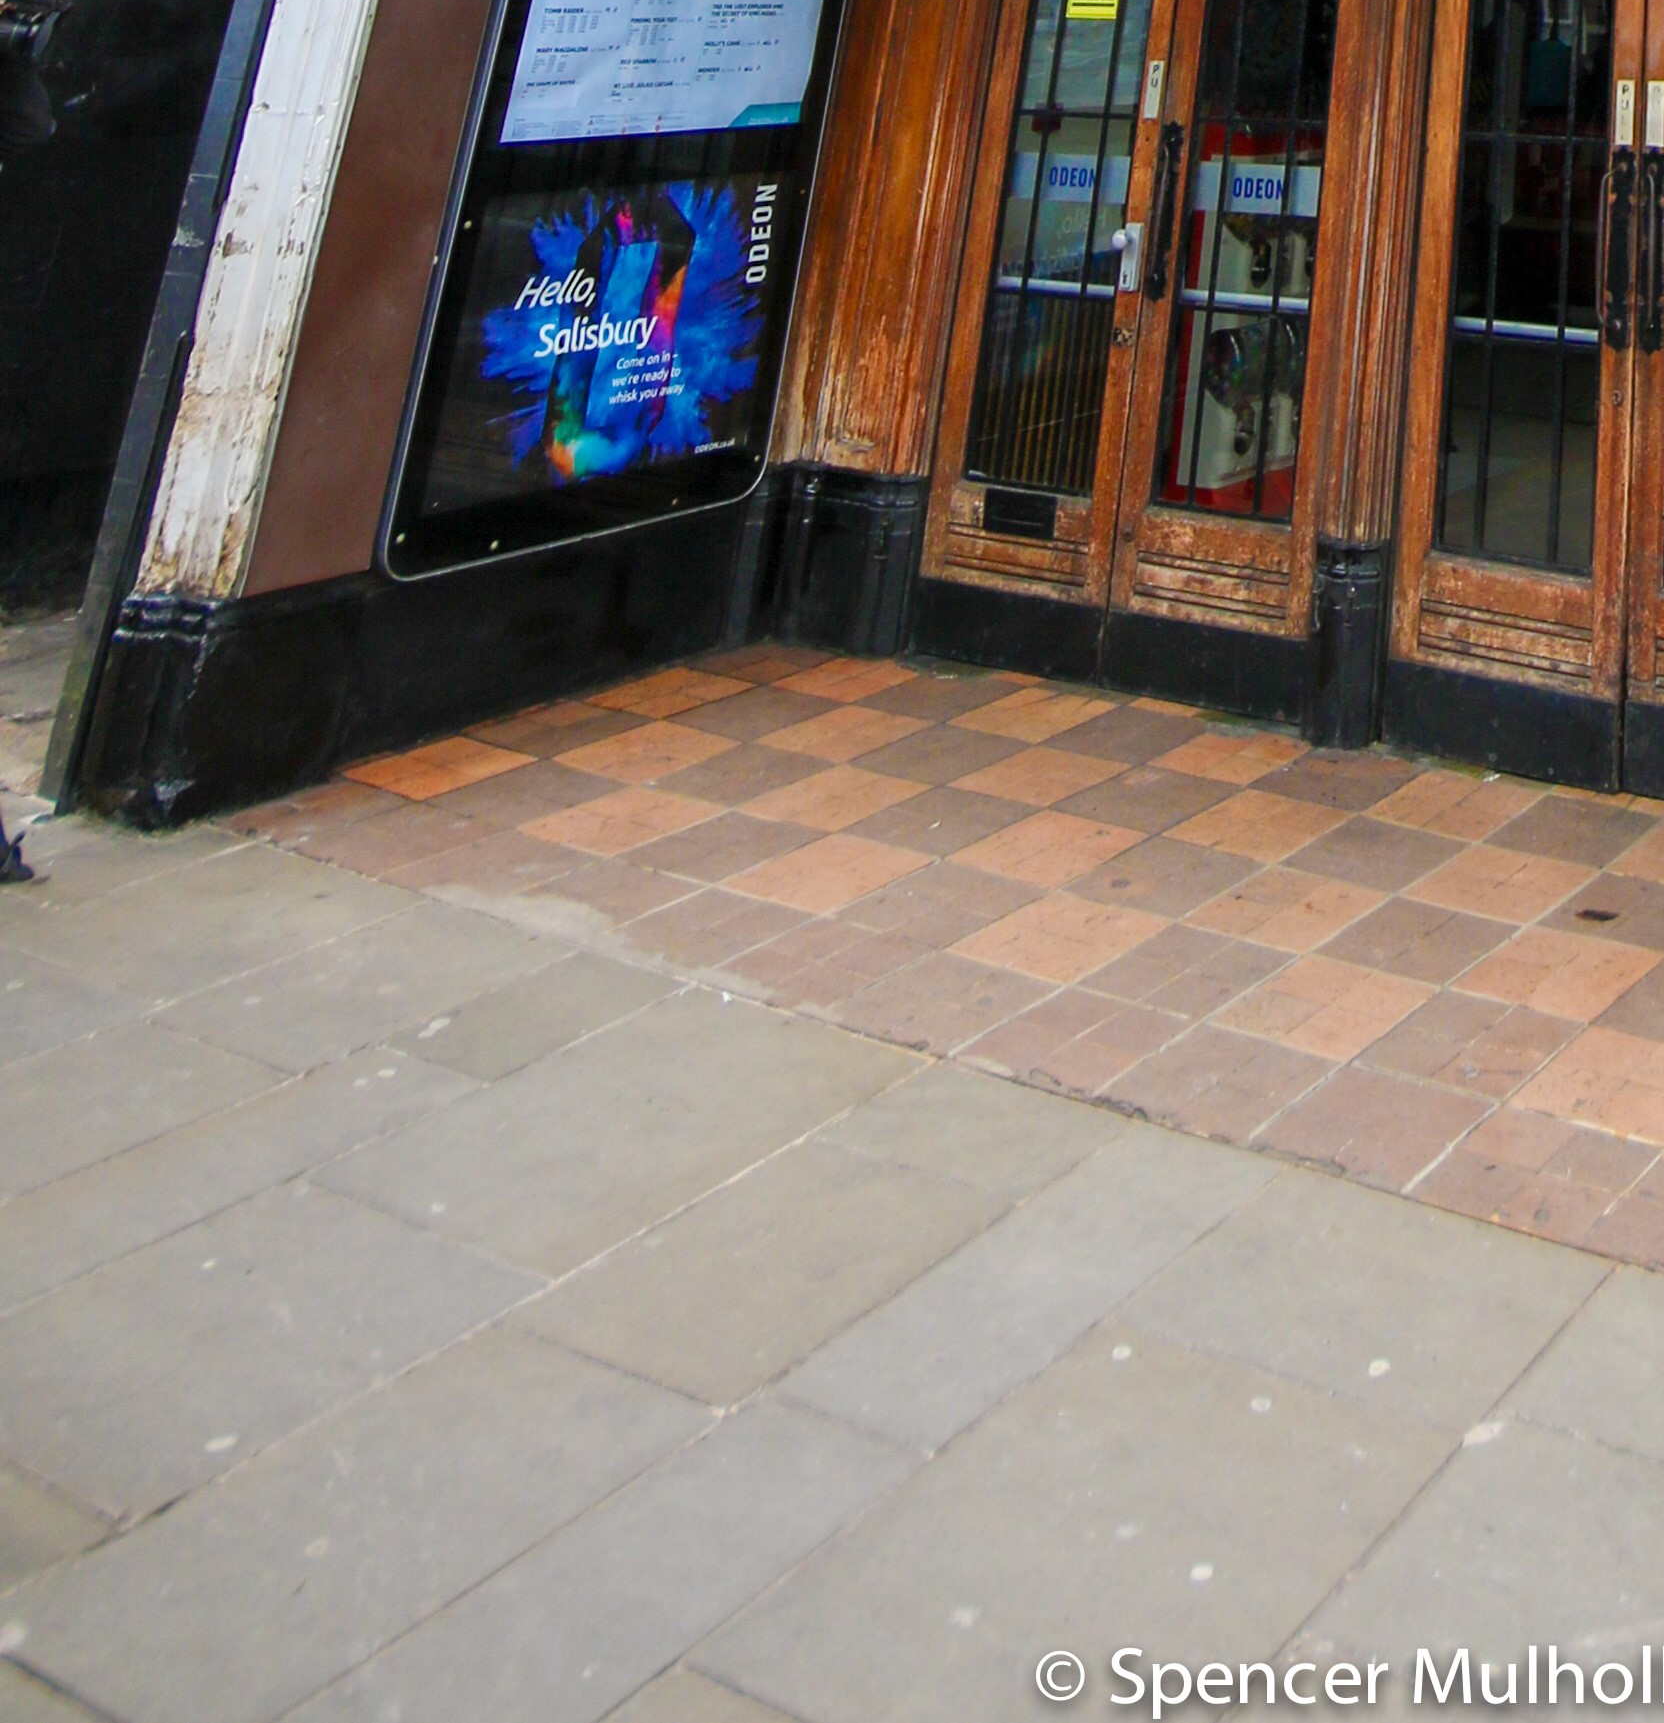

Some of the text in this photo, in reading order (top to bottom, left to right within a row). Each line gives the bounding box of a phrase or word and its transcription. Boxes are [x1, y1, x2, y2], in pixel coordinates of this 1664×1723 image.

[745, 183, 778, 284] ODEON
[513, 267, 598, 311] Hello,
[533, 312, 659, 359] Salisbury
[611, 365, 682, 388] we're ready to
[616, 357, 645, 371] Come
[646, 356, 660, 367] on
[660, 351, 671, 366] in
[608, 382, 685, 405] whisk you away
